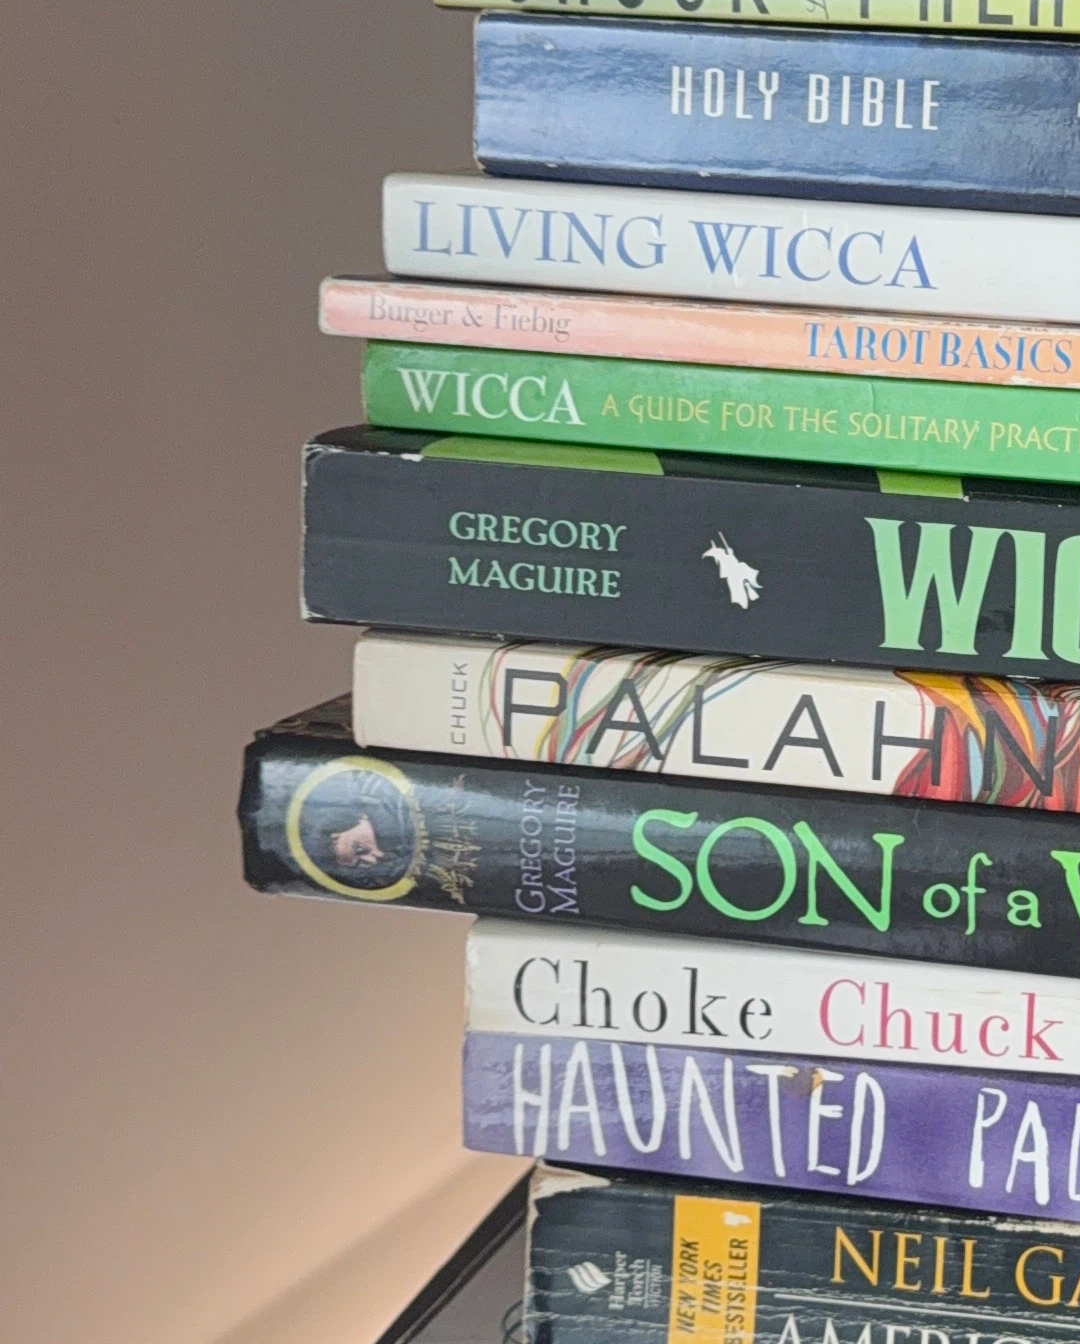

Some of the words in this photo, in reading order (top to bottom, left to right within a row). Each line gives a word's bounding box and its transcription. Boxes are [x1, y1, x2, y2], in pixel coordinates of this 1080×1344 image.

[671, 66, 780, 120] HOLY
[807, 73, 940, 131] BIBLE
[412, 200, 667, 269] LIVING
[688, 219, 939, 291] WICCA
[368, 295, 454, 331] Burger
[460, 306, 484, 328] &
[494, 305, 572, 343] Fiebig
[804, 322, 930, 365] TAROT
[940, 331, 1073, 374] BASICS
[396, 367, 586, 426] WICCA
[601, 397, 619, 417] A
[629, 396, 710, 424] GUIDE
[721, 401, 774, 430] FOR
[783, 405, 837, 435] THE
[848, 411, 980, 449] SOLITARY
[449, 510, 628, 552] GREGORY
[448, 556, 621, 598] MAGUIRE
[451, 662, 468, 745] CHUCK
[515, 779, 546, 913] GREGORY
[547, 785, 581, 915] MAGUIRE
[631, 808, 905, 933] SON
[922, 852, 993, 935] of
[1006, 889, 1042, 929] a
[513, 957, 774, 1041] Choke
[819, 978, 1064, 1063] Chuck
[513, 1040, 885, 1187] HAUNTED
[608, 1250, 631, 1310] Harper
[679, 1237, 699, 1284] YORK
[702, 1259, 723, 1315] TIMES
[830, 1226, 990, 1299] NEIL
[676, 1290, 697, 1335] NEW
